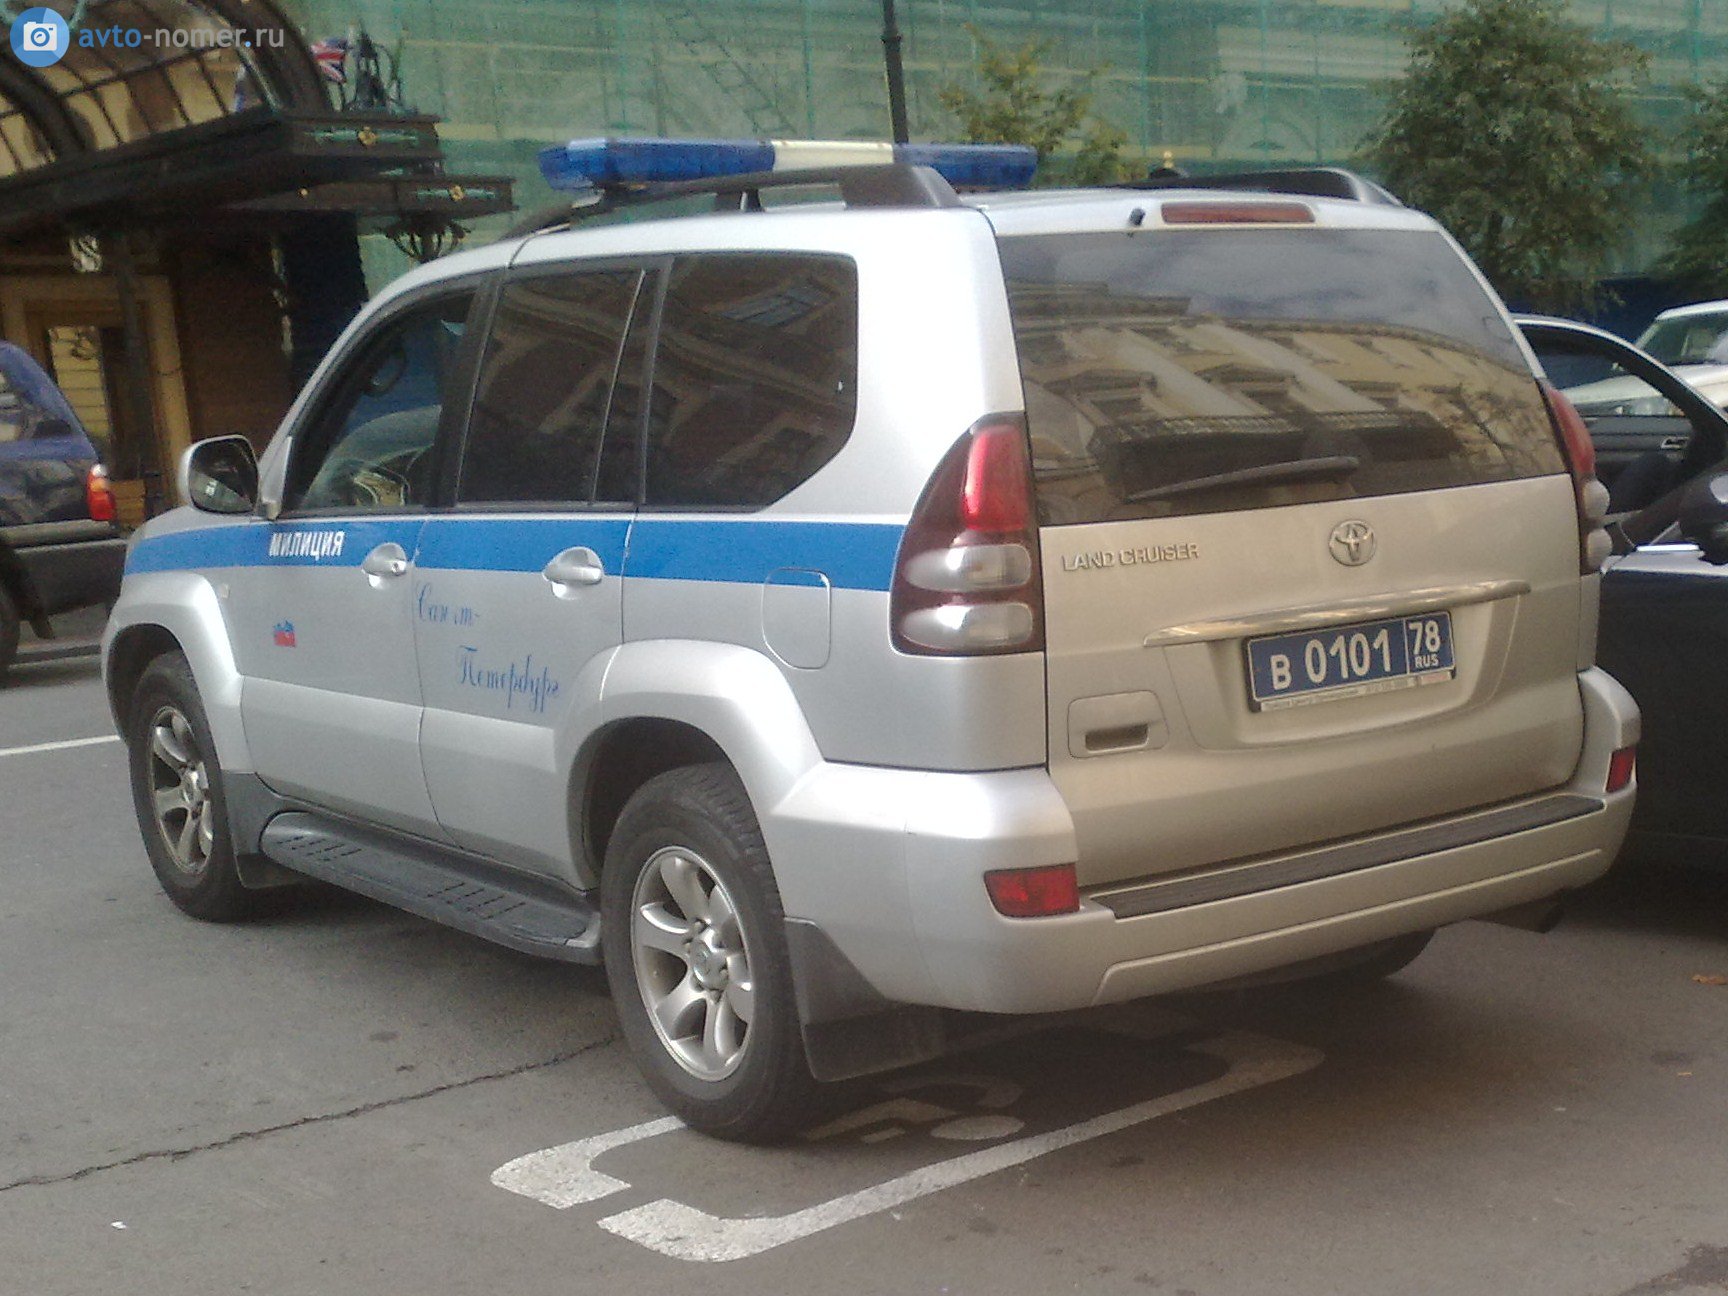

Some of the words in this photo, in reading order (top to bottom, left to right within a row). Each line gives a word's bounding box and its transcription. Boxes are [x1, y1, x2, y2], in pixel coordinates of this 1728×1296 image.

[269, 531, 345, 560] МИЛИЦИЯ
[1062, 550, 1114, 571] LAND
[1304, 628, 1391, 684] 0101
[1408, 620, 1441, 655] 78
[1414, 655, 1439, 668] RUS
